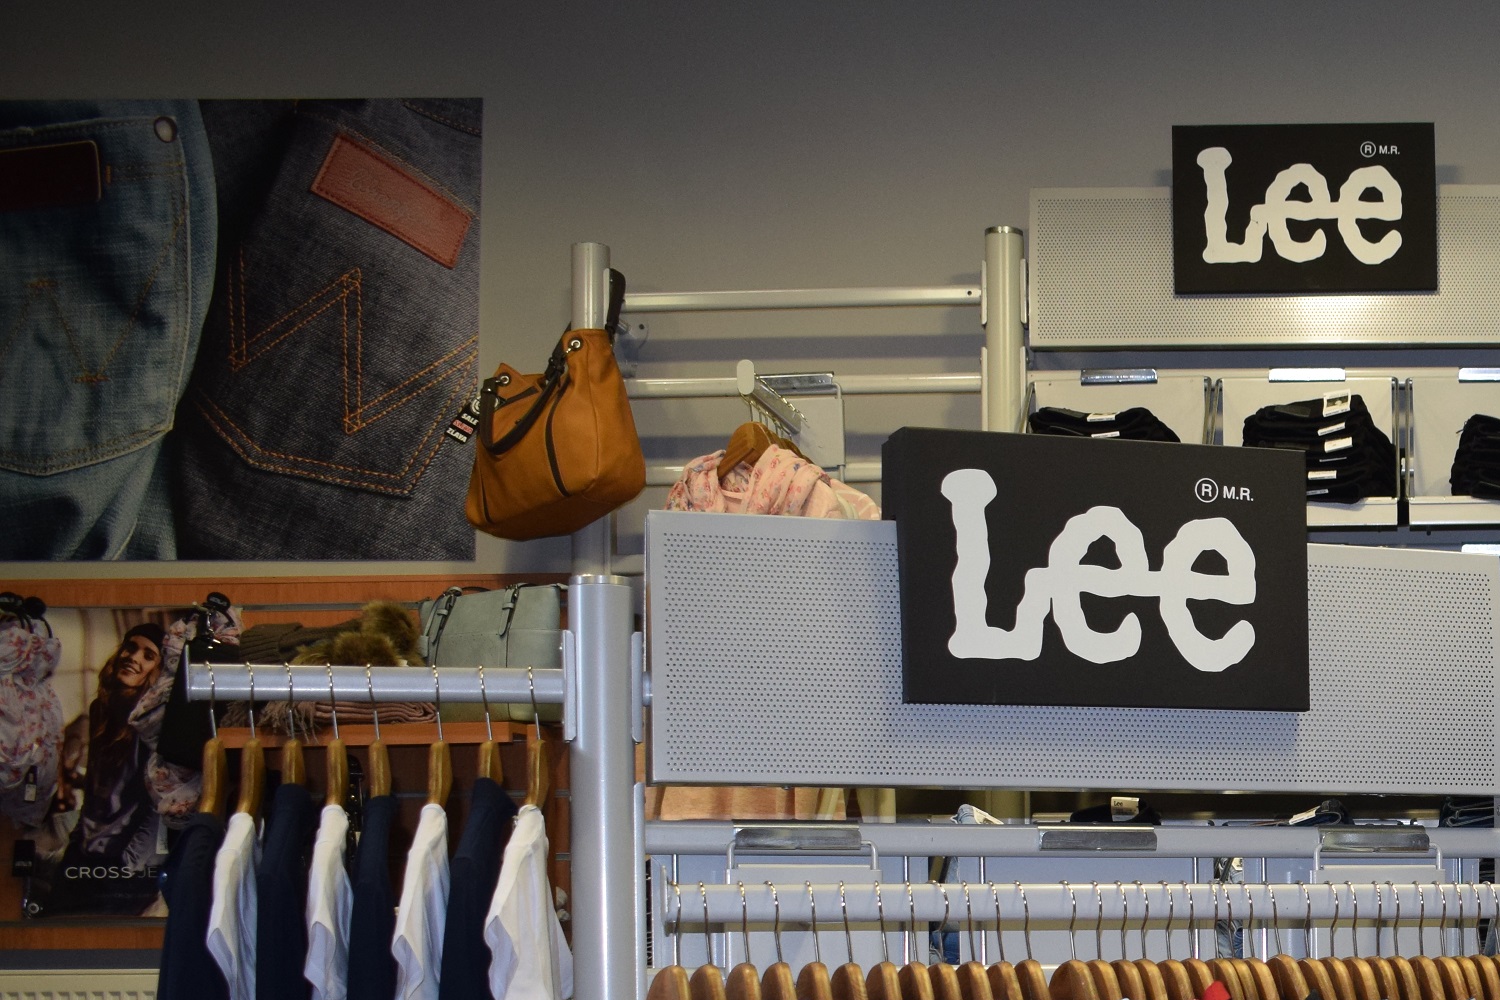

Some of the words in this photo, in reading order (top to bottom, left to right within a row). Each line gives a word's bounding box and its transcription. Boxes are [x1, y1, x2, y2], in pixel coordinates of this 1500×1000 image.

[1378, 145, 1400, 155] M.R.
[1196, 146, 1403, 266] Lee
[461, 413, 479, 426] SALE
[1222, 485, 1254, 502] M.R.
[940, 468, 1257, 673] Lee
[65, 866, 134, 879] CROSS
